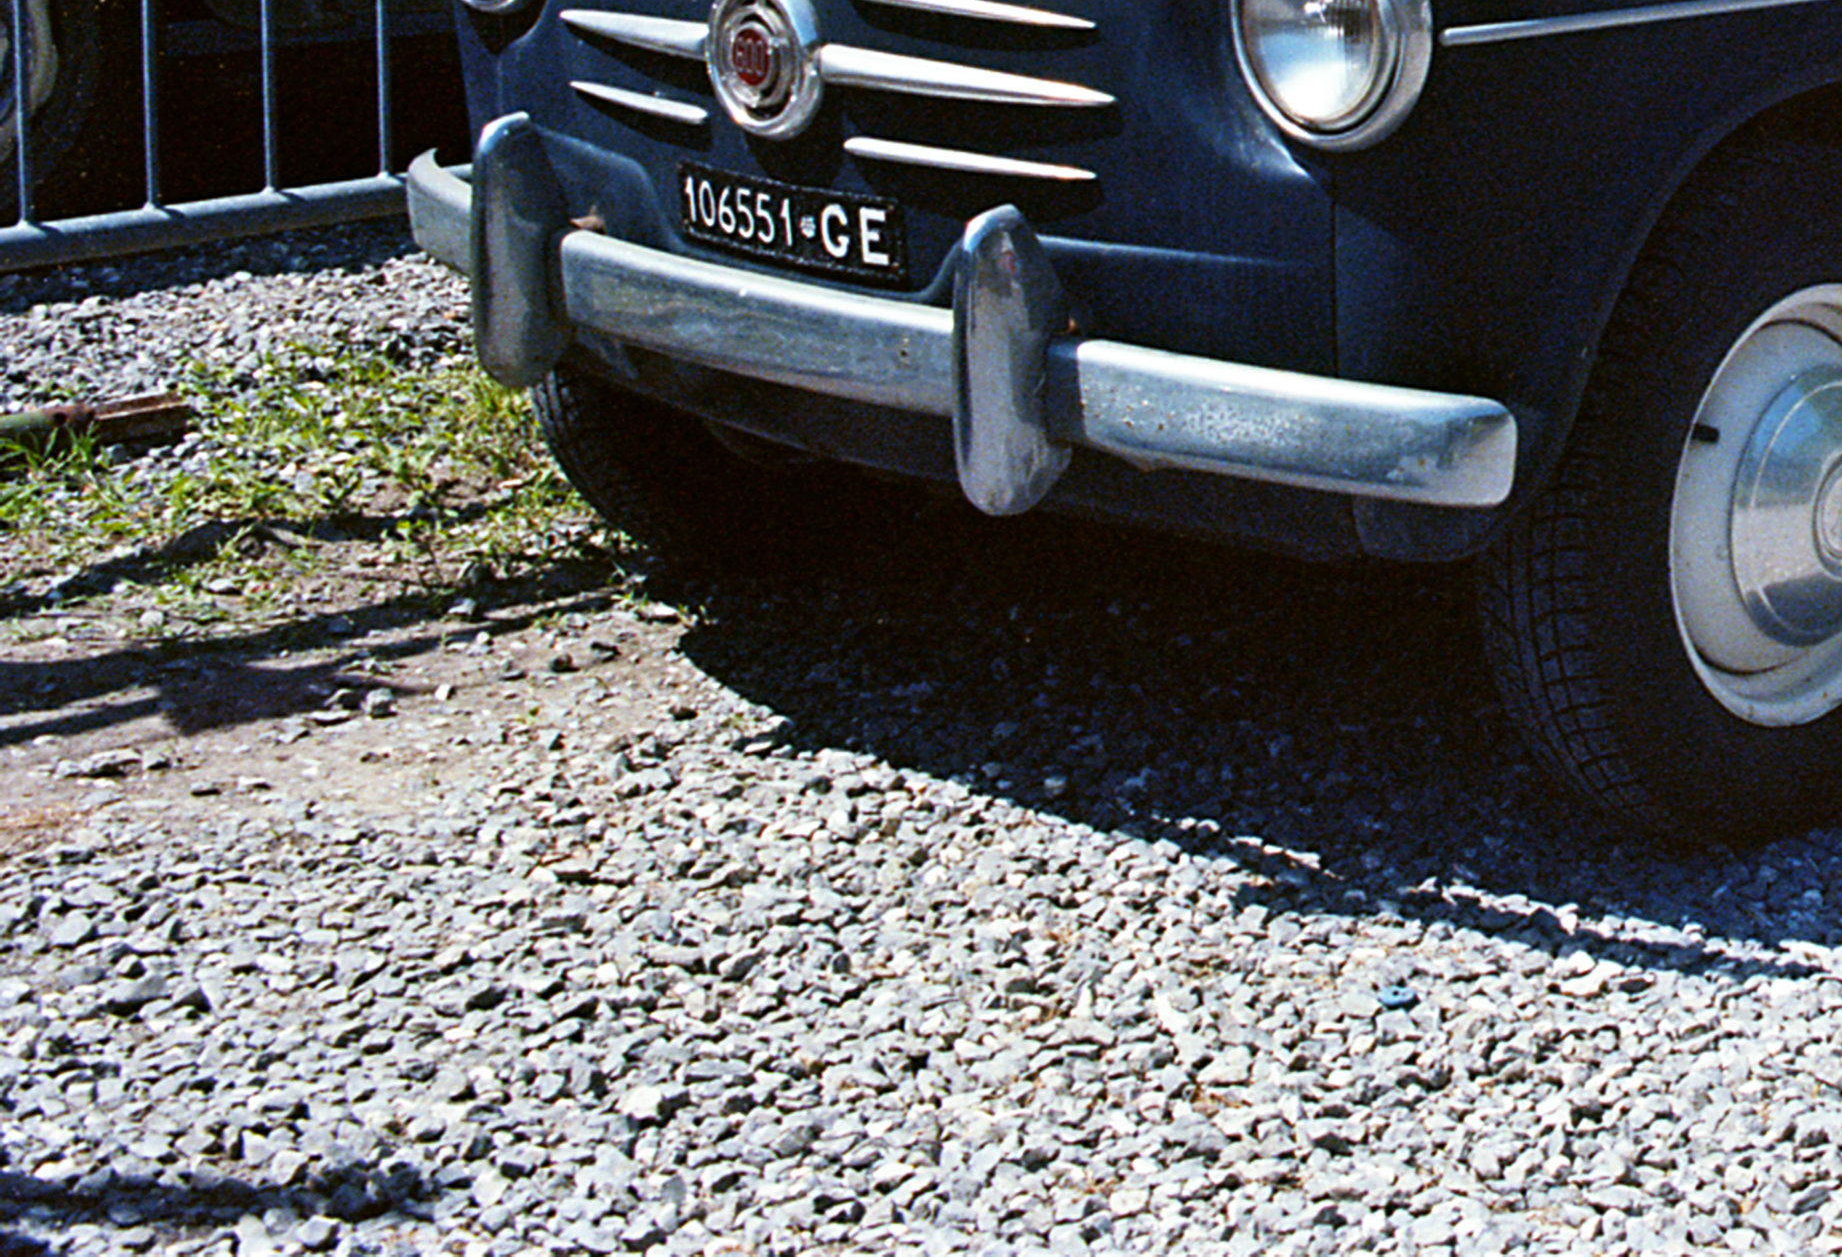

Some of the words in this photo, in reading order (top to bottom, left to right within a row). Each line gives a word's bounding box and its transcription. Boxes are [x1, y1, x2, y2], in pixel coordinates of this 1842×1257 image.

[734, 36, 765, 76] 600
[685, 176, 793, 246] 106551
[820, 204, 890, 265] GE
